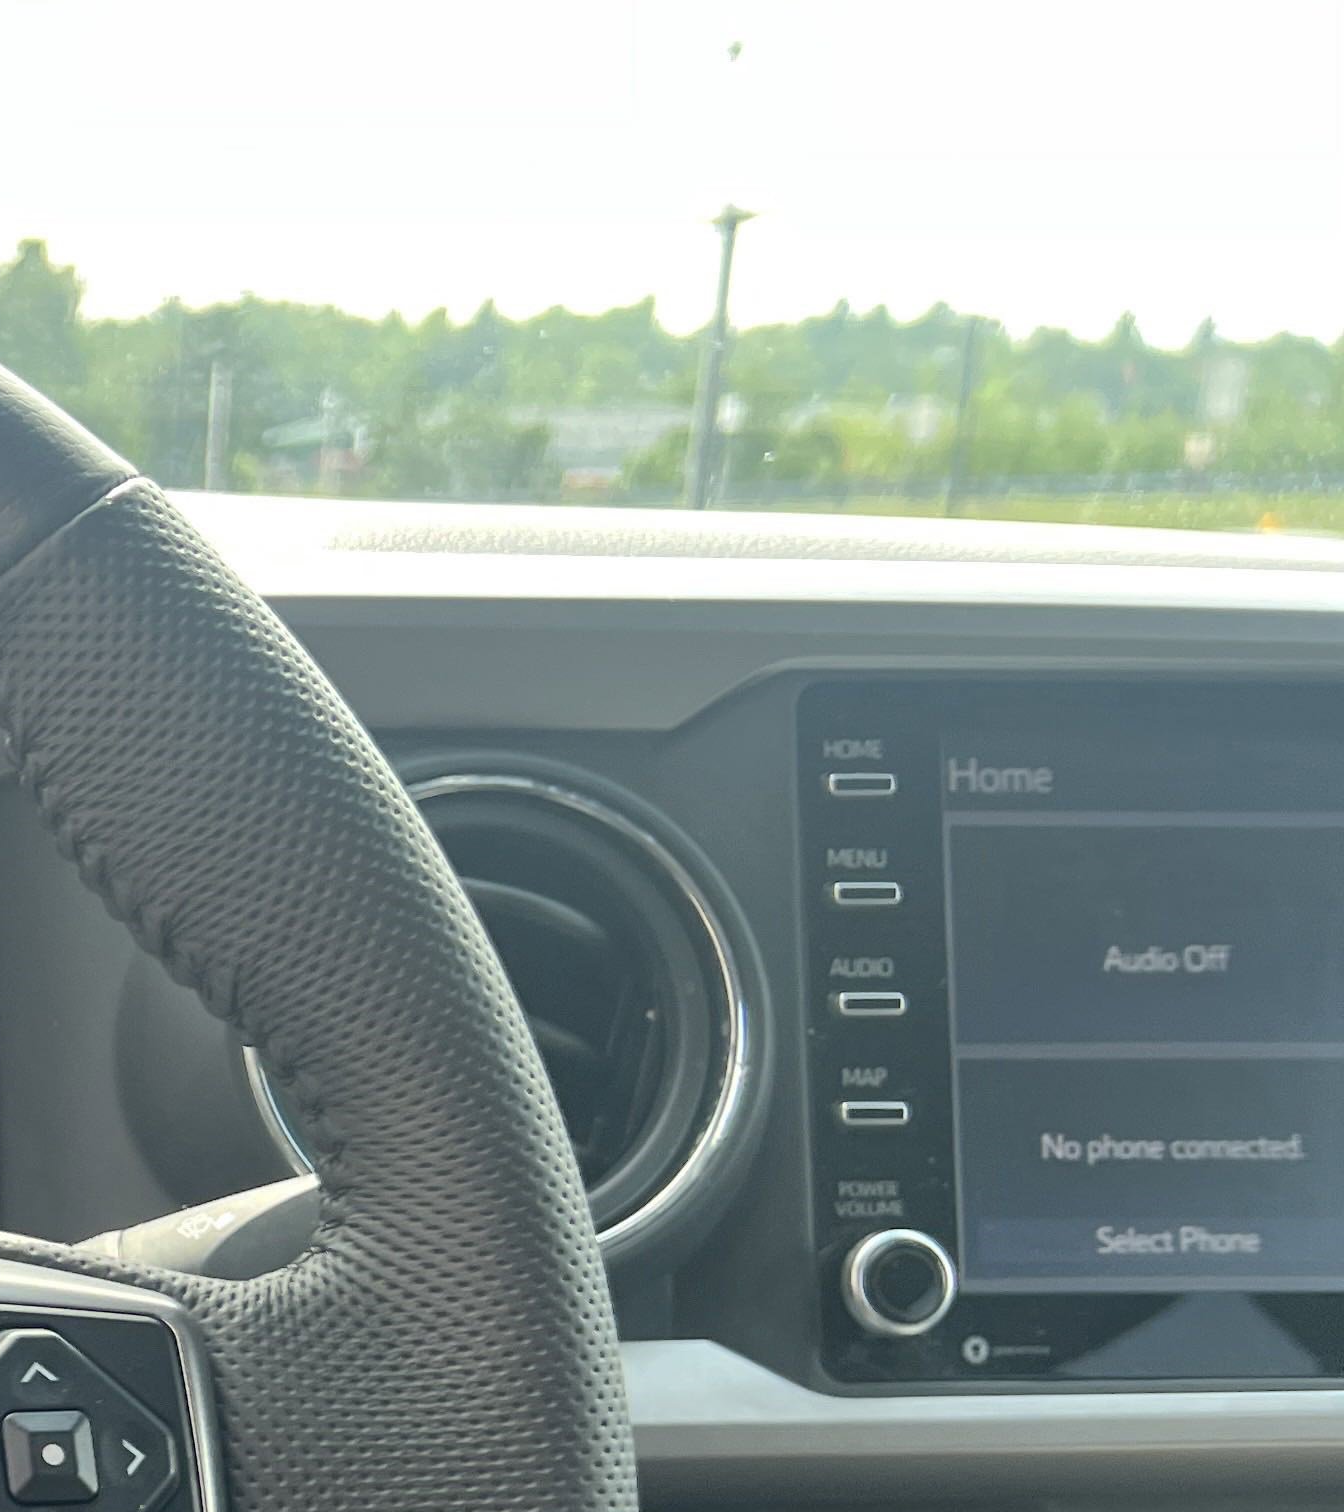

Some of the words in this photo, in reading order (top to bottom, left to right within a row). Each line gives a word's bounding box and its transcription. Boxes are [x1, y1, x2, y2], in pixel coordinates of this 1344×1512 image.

[823, 739, 884, 759] HOME
[948, 758, 1055, 794] Home
[826, 848, 888, 869] MENU
[829, 957, 895, 978] AUDIO
[1103, 945, 1178, 973] Audio
[1183, 945, 1233, 972] Off
[841, 1067, 888, 1088] MAP
[1042, 1133, 1080, 1160] No
[1087, 1134, 1165, 1165] phone
[1170, 1133, 1306, 1161] connected.
[838, 1180, 899, 1198] POWER
[835, 1198, 904, 1217] VOLUME
[1096, 1226, 1175, 1255] Select
[1181, 1226, 1261, 1254] Phone
